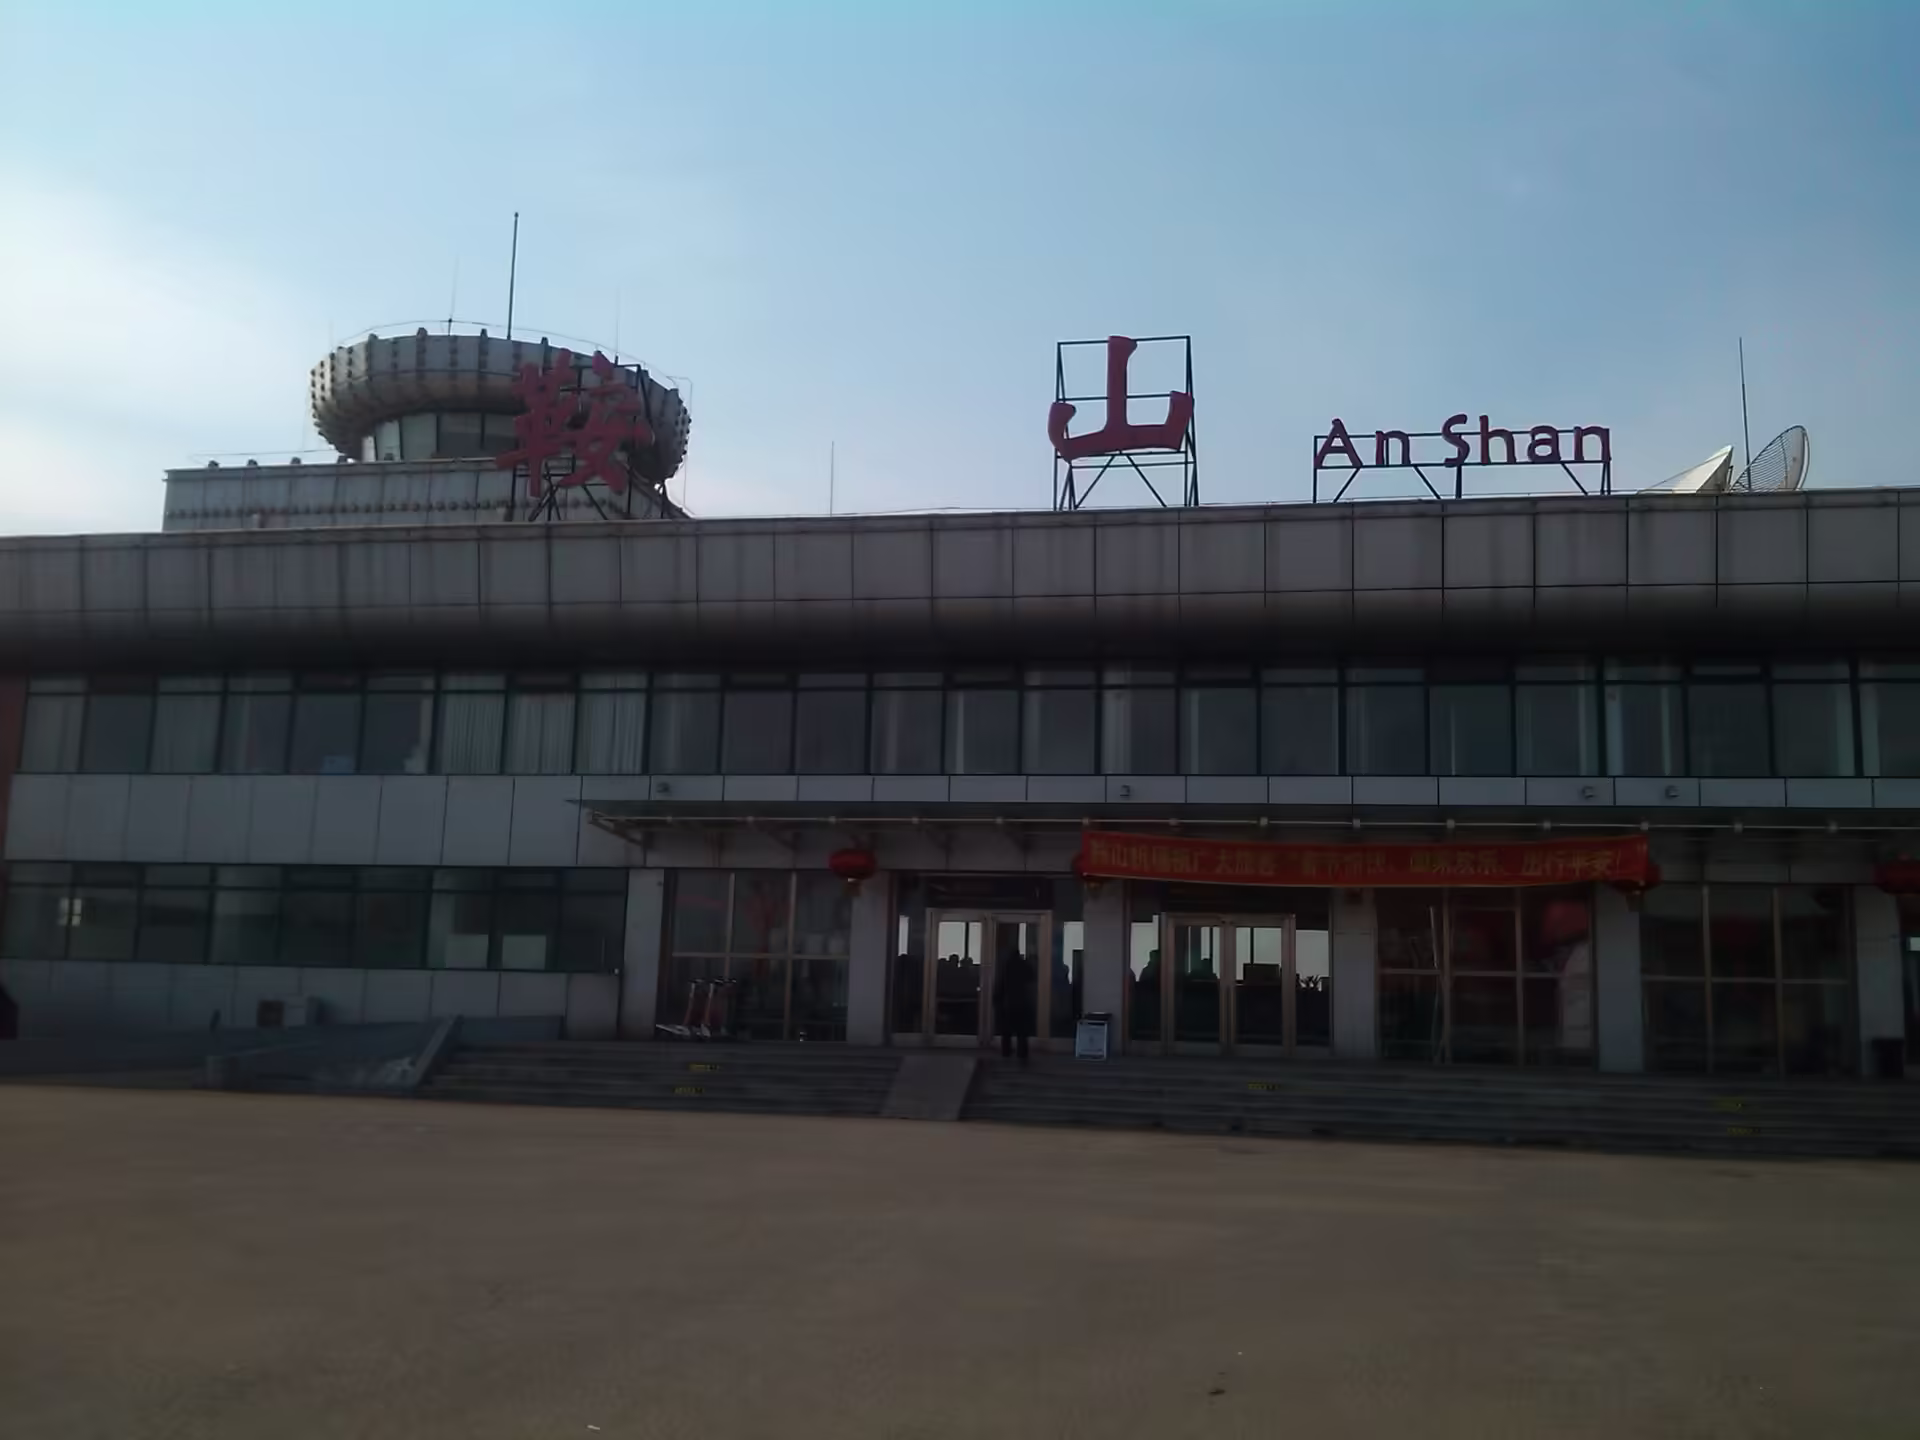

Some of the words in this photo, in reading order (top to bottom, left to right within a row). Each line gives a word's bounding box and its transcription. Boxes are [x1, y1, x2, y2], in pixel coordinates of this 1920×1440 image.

[494, 348, 650, 497] 鞍
[1048, 335, 1193, 464] 山
[1314, 418, 1411, 468] An
[1442, 414, 1611, 467] Shan
